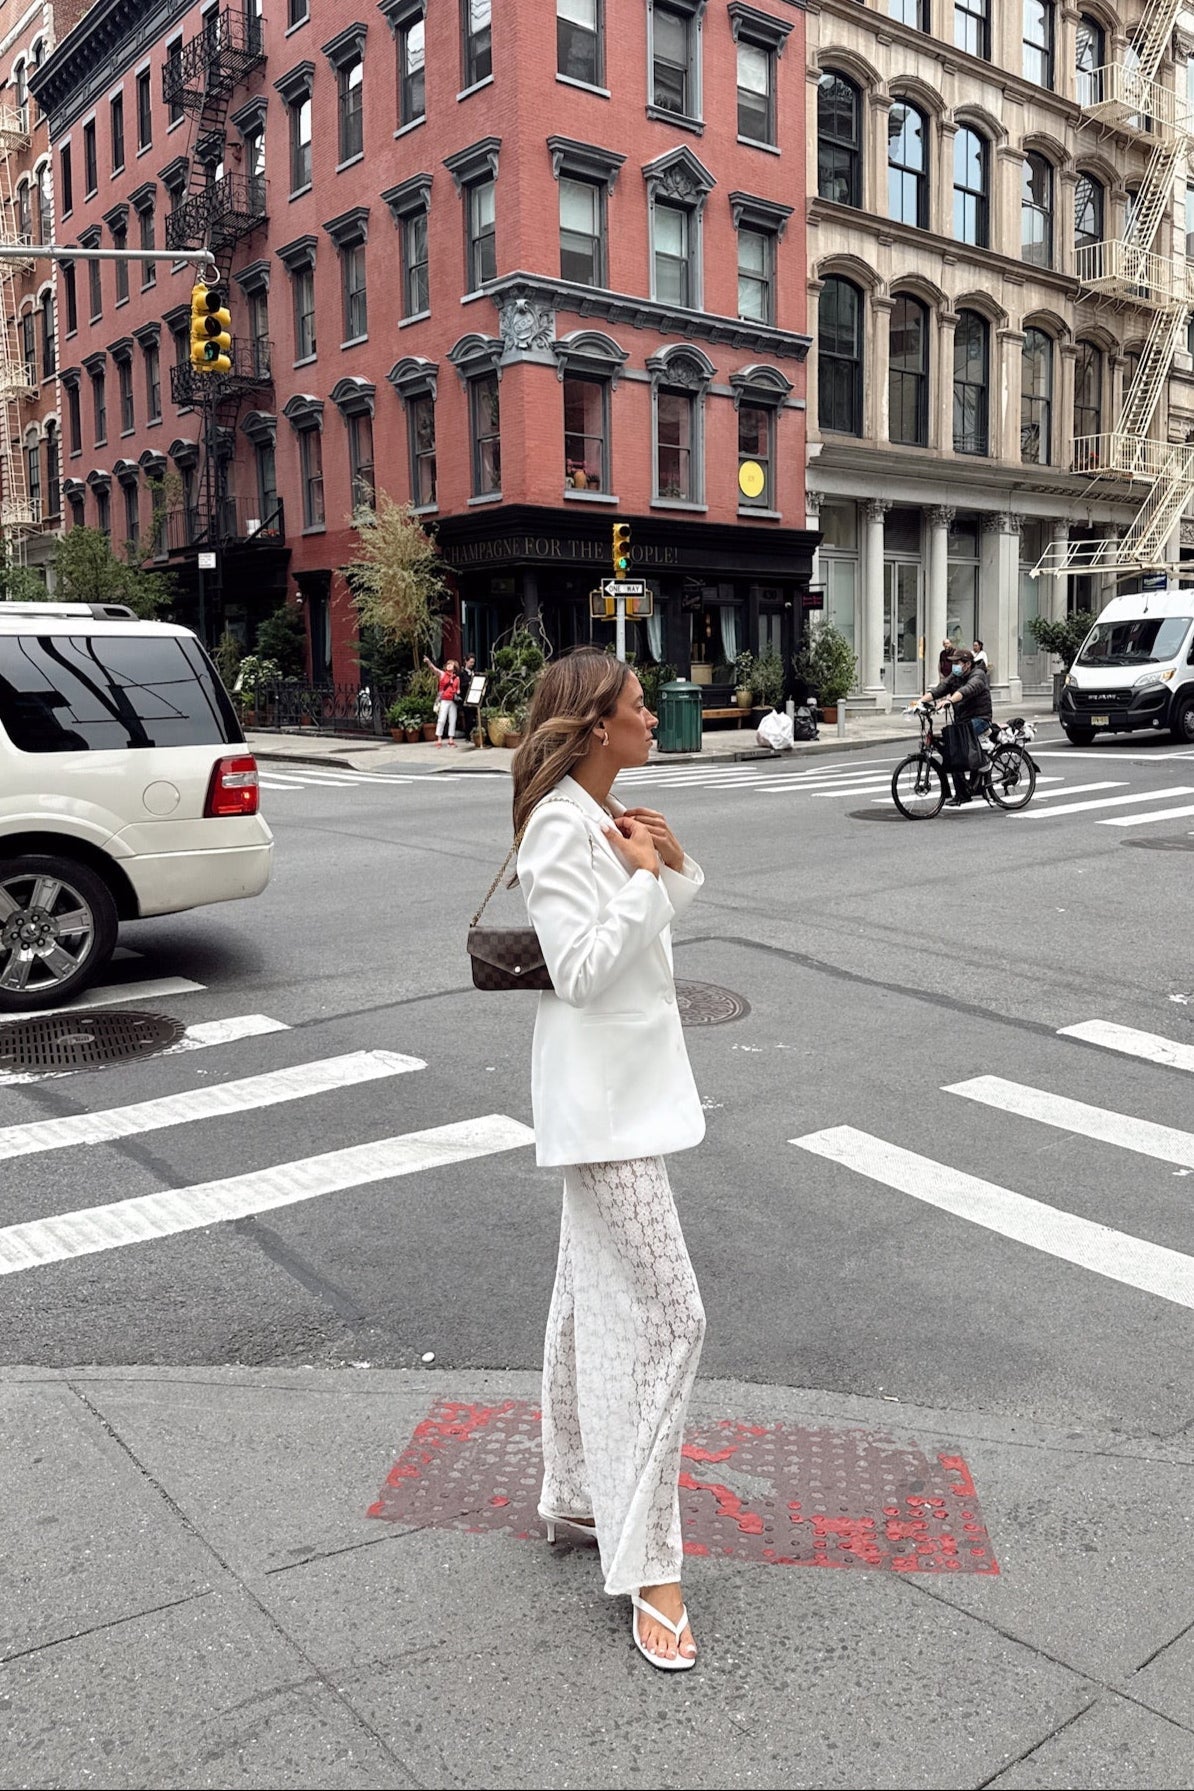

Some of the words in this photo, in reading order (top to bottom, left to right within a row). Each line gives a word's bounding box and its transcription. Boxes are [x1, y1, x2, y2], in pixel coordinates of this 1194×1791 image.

[444, 537, 520, 563] CHAMPAGNE
[525, 537, 561, 556] FOR
[568, 540, 603, 558] THE
[631, 544, 678, 563] OPLE!
[609, 585, 622, 593] ONE
[627, 585, 640, 593] WAY
